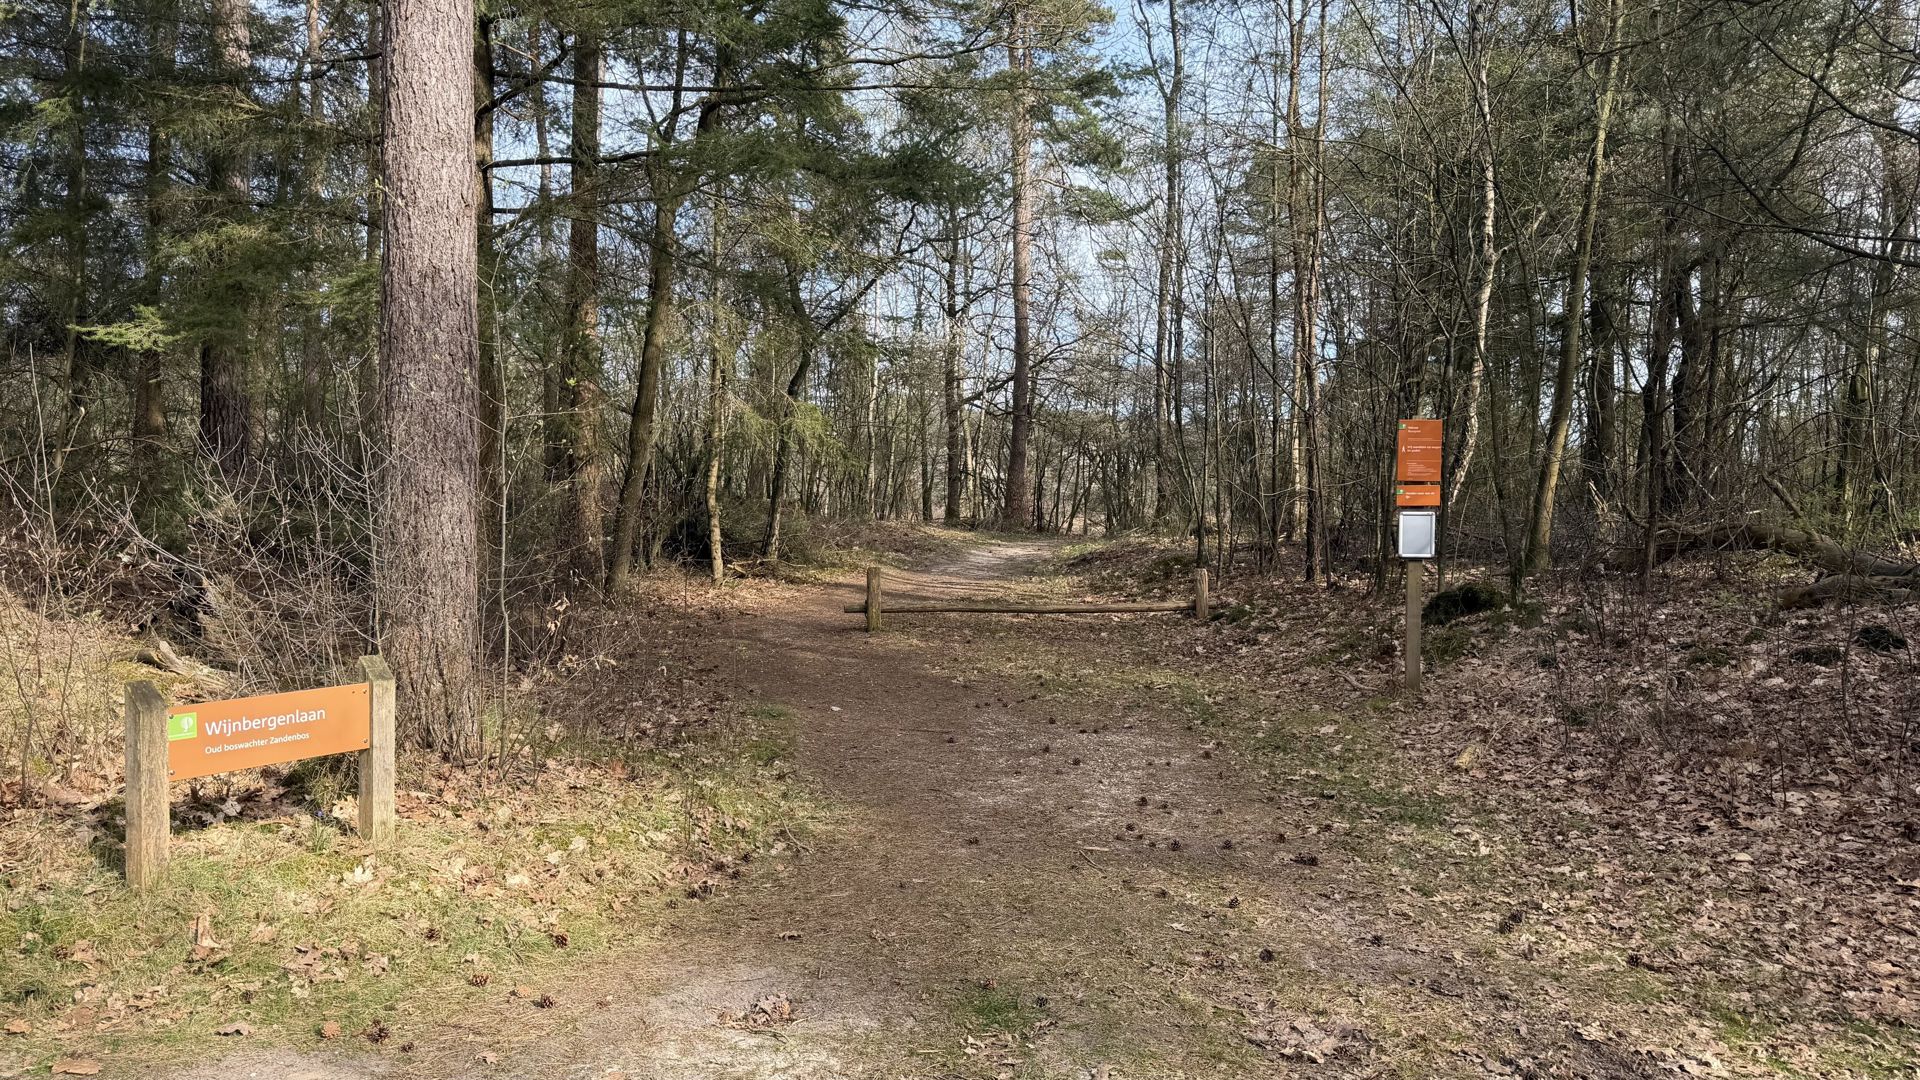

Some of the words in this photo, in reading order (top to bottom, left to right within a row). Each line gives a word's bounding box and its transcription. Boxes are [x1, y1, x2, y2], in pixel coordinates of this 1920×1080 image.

[204, 708, 326, 737] Wijnbergenlaan
[204, 744, 222, 755] Oud
[223, 739, 269, 752] boswachter
[269, 732, 310, 745] Zandenbos
